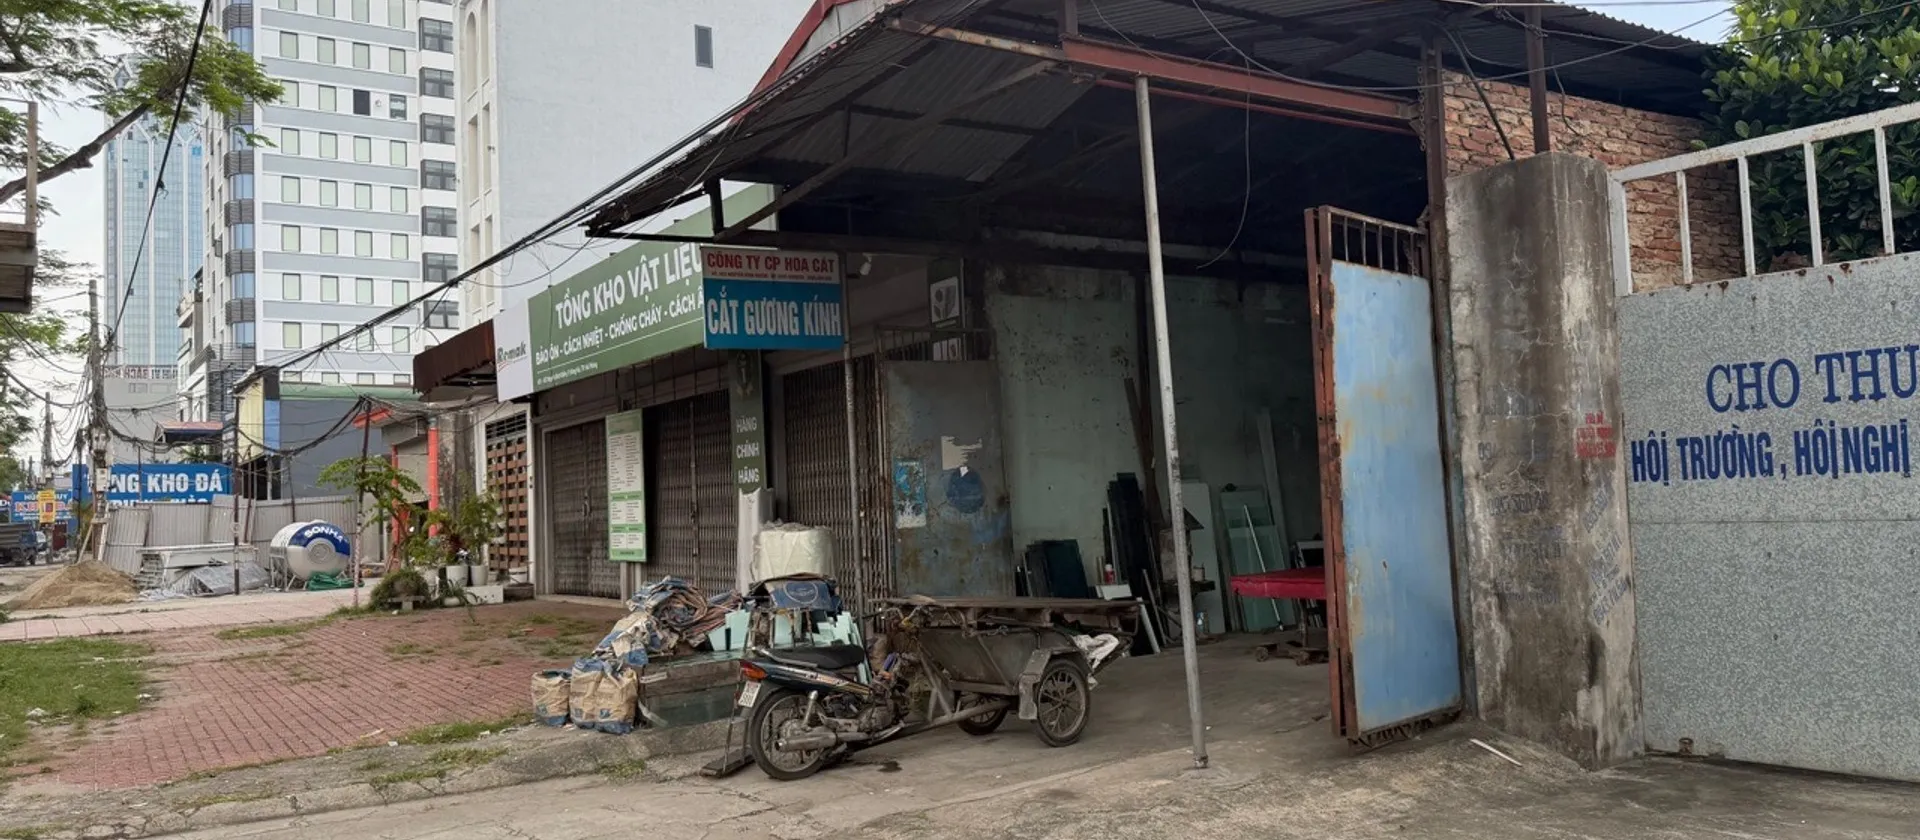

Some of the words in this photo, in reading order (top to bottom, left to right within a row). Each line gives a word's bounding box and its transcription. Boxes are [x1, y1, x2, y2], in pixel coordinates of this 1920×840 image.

[707, 251, 743, 269] CÔNG
[746, 255, 761, 270] TY
[764, 256, 781, 271] CP
[784, 257, 810, 272] HOA
[555, 287, 591, 329] TỔNG
[593, 275, 626, 315] KHO
[627, 255, 660, 302] VẬT
[663, 242, 703, 286] LIỆU
[563, 336, 582, 356] CÁCH
[582, 327, 604, 348] NHIỆT
[608, 318, 638, 340] CHỐNG
[638, 302, 663, 329] CHÁY
[669, 290, 696, 318] CÁCH
[707, 285, 739, 335] CẮT
[744, 297, 800, 336] GƯƠNG
[802, 294, 842, 337] KÍNH
[1706, 358, 1800, 413] CHO
[736, 416, 757, 433] HÀNG
[736, 439, 760, 459] CHÍNH
[1676, 424, 1774, 481] TRƯỜNG
[1841, 419, 1911, 478] NGHỊ
[147, 473, 189, 493] KHO
[195, 469, 223, 493] ĐÁ
[738, 466, 760, 484] HÀNG
